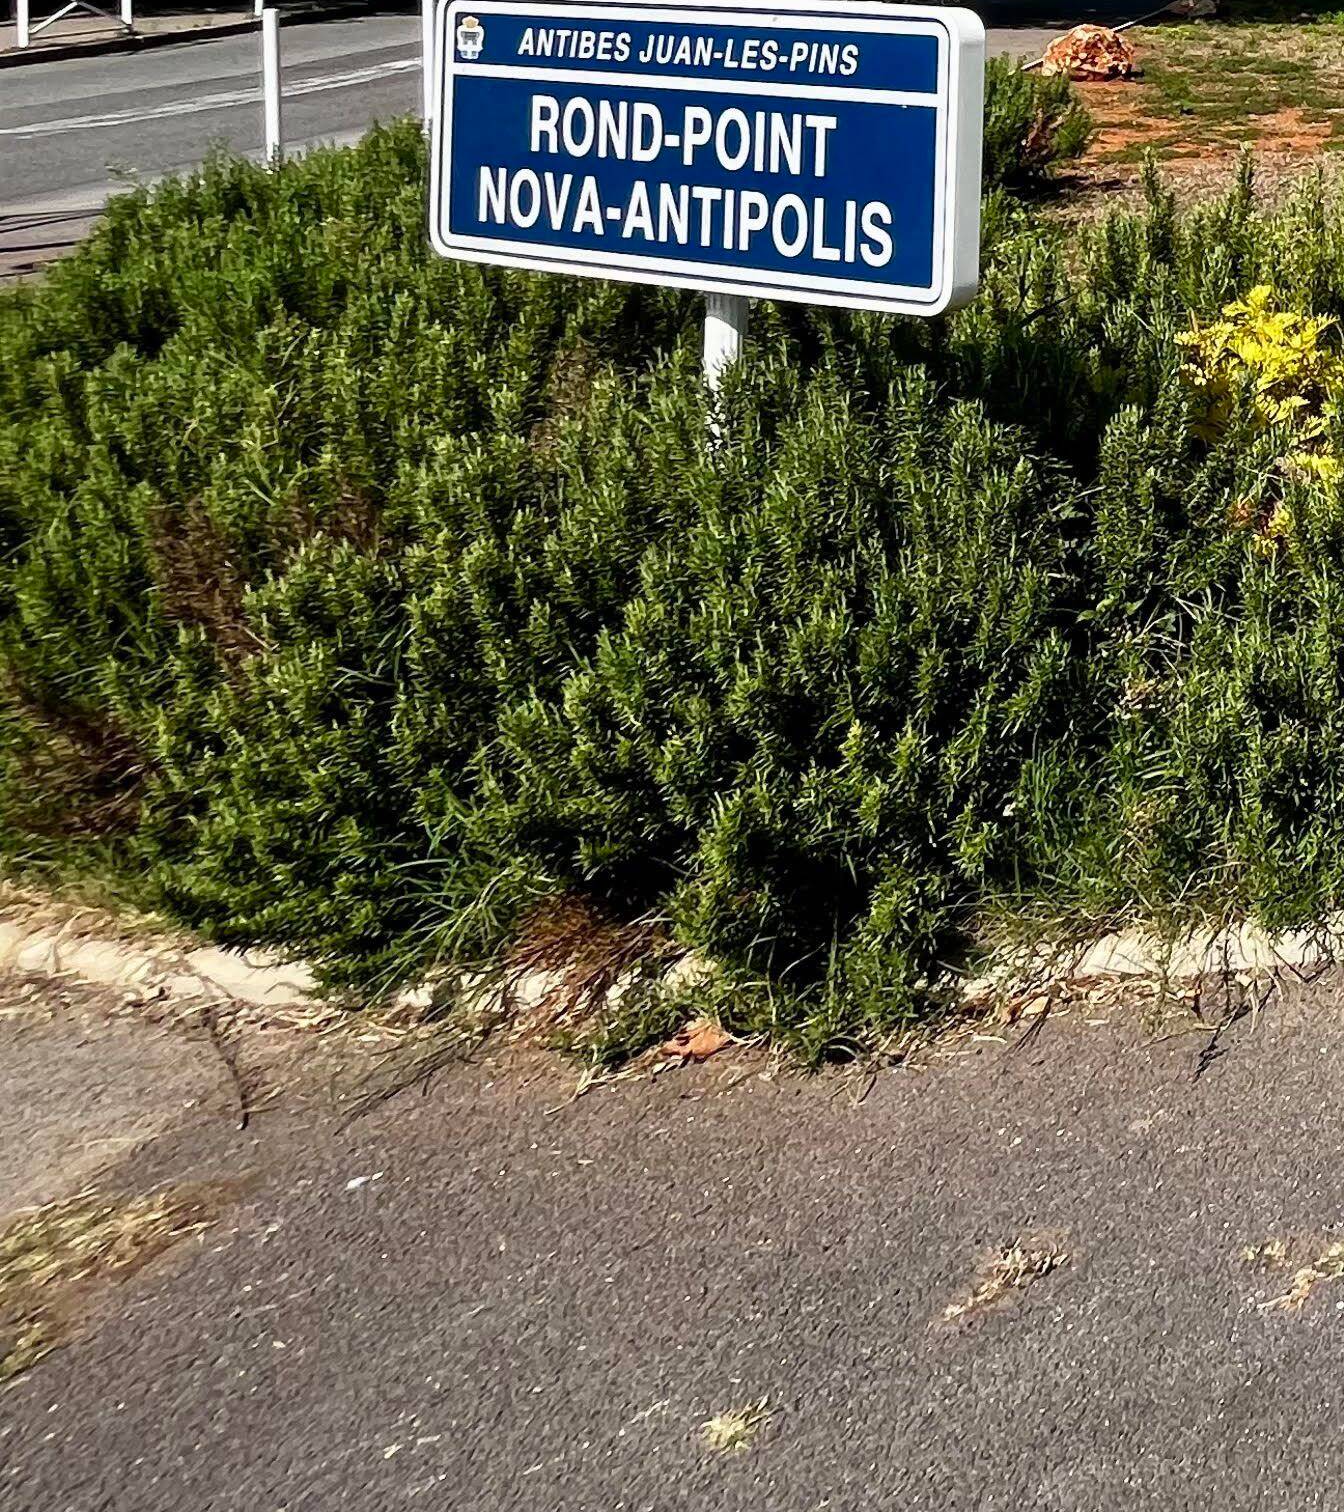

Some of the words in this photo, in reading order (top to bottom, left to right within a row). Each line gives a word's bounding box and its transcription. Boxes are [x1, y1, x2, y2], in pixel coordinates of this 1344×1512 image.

[517, 27, 632, 63] ANTIBES
[638, 34, 860, 77] JUAN-LES-PINS
[529, 94, 838, 178] ROND-POINT
[477, 165, 894, 268] NOVA-ANTIPOLIS
